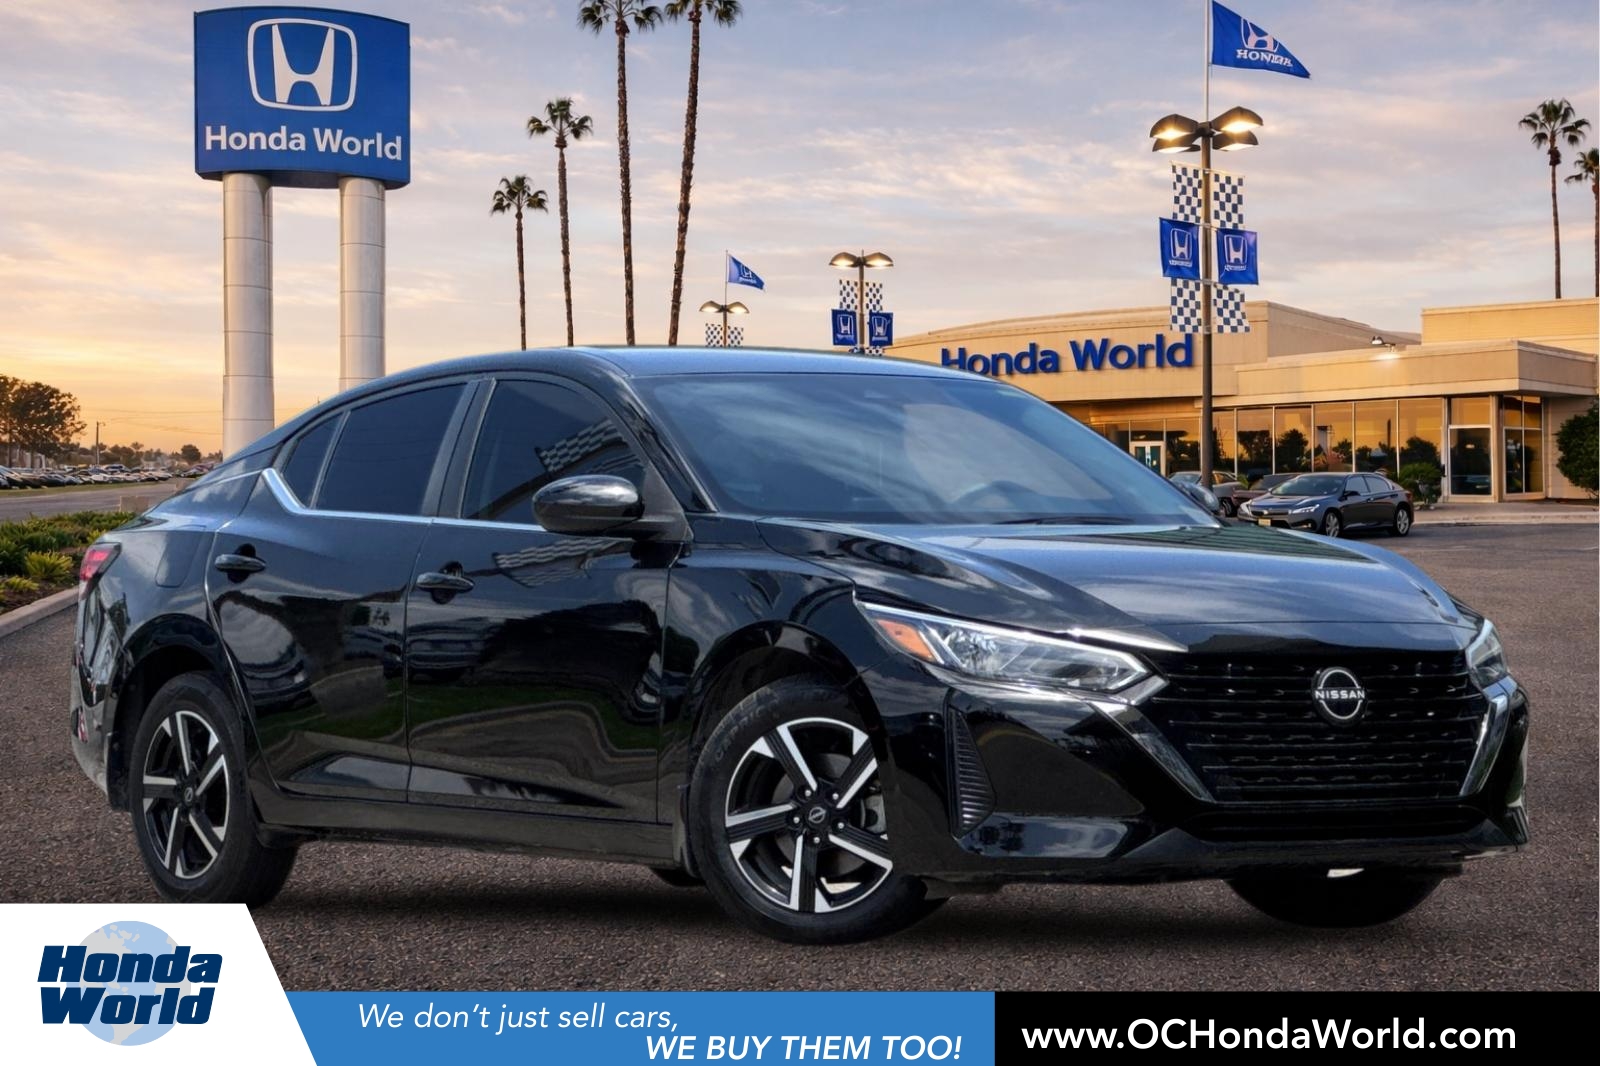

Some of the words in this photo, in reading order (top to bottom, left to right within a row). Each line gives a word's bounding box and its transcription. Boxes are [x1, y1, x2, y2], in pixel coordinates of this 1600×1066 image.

[205, 126, 306, 151] Honda
[313, 127, 402, 161] World
[941, 342, 1059, 376] Honda
[1069, 333, 1194, 371] World
[1315, 689, 1365, 699] NISSAN
